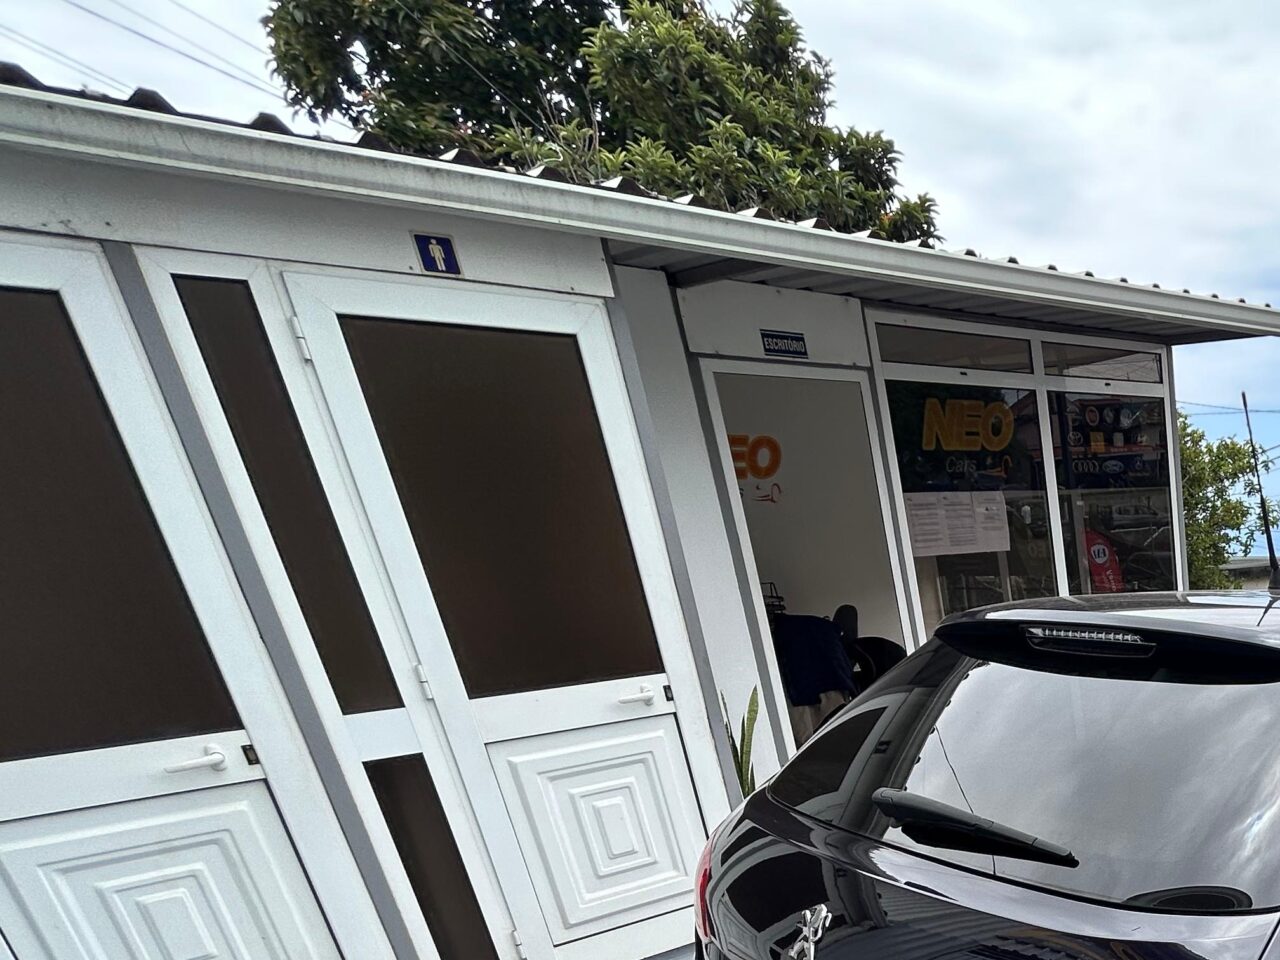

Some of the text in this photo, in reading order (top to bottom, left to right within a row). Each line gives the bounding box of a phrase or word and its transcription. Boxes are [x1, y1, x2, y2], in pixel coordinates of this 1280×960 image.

[763, 337, 805, 352] ESCRITÓRIO
[922, 397, 1014, 451] NEO
[728, 434, 782, 481] EO
[945, 456, 977, 473] Cars
